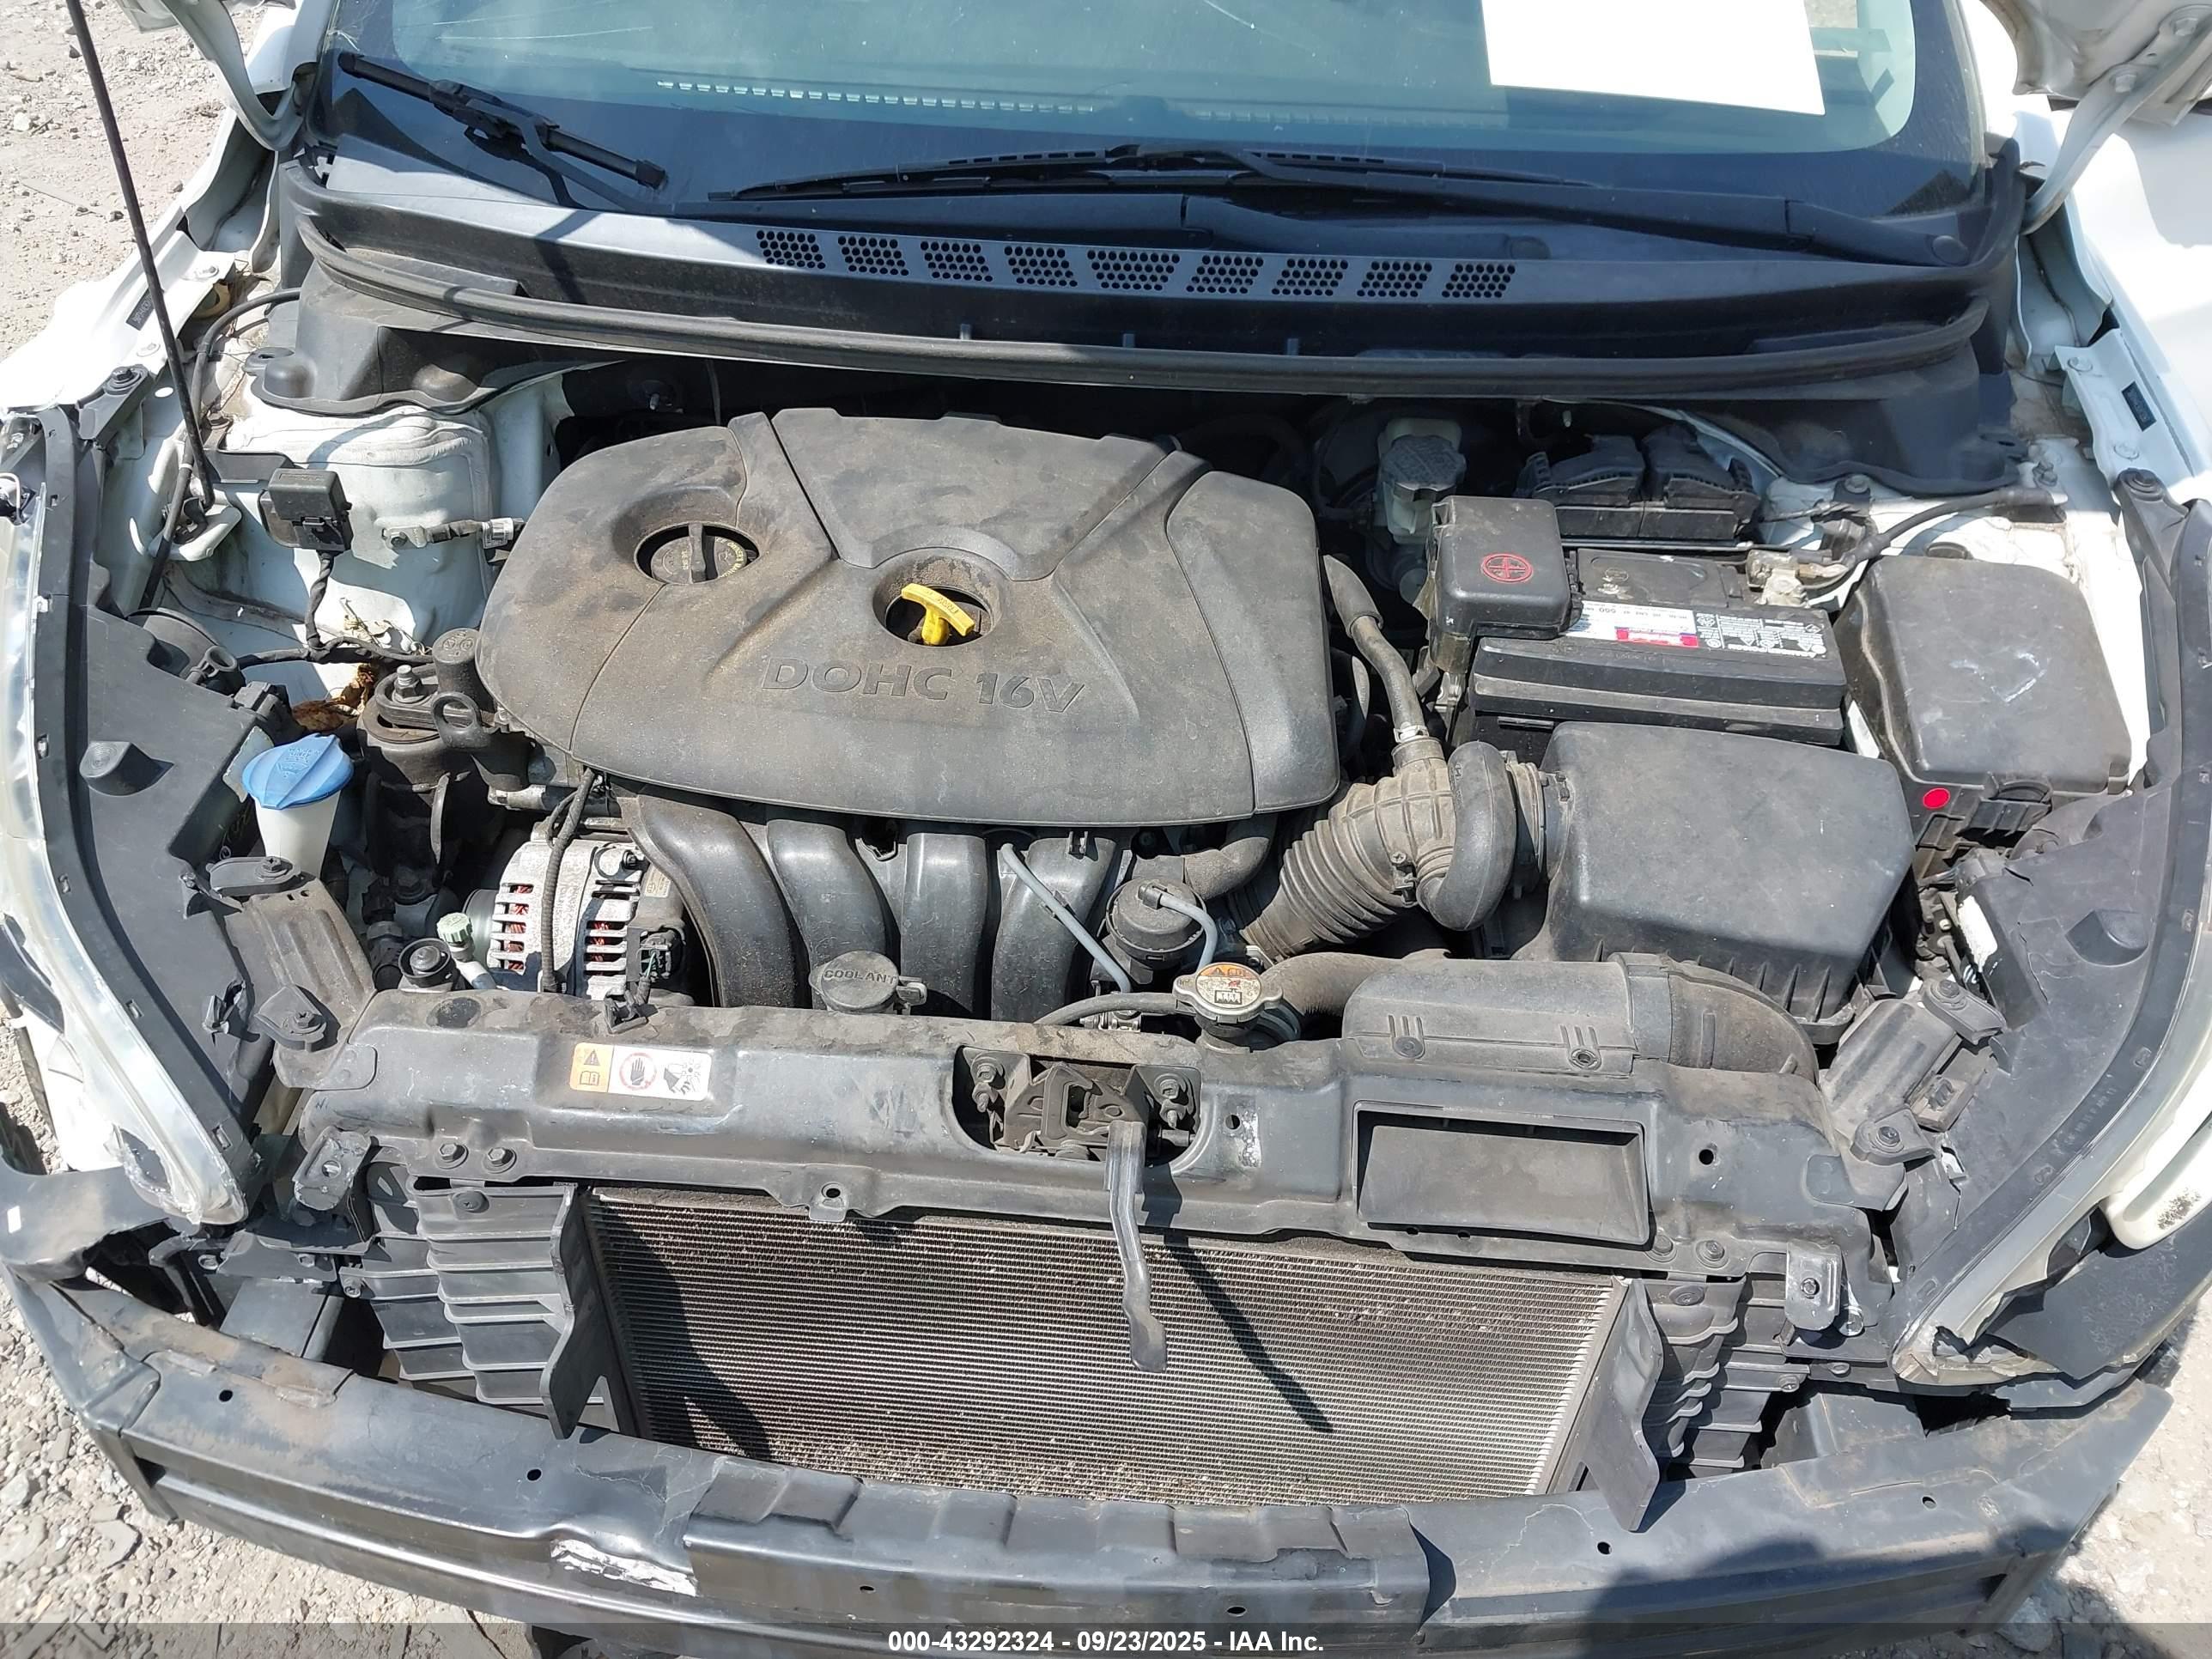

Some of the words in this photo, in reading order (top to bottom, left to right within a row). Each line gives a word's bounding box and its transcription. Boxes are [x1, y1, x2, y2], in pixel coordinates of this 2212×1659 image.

[762, 658, 952, 700] DOHC
[975, 672, 1085, 713] 16V
[823, 969, 897, 985] COOLANT
